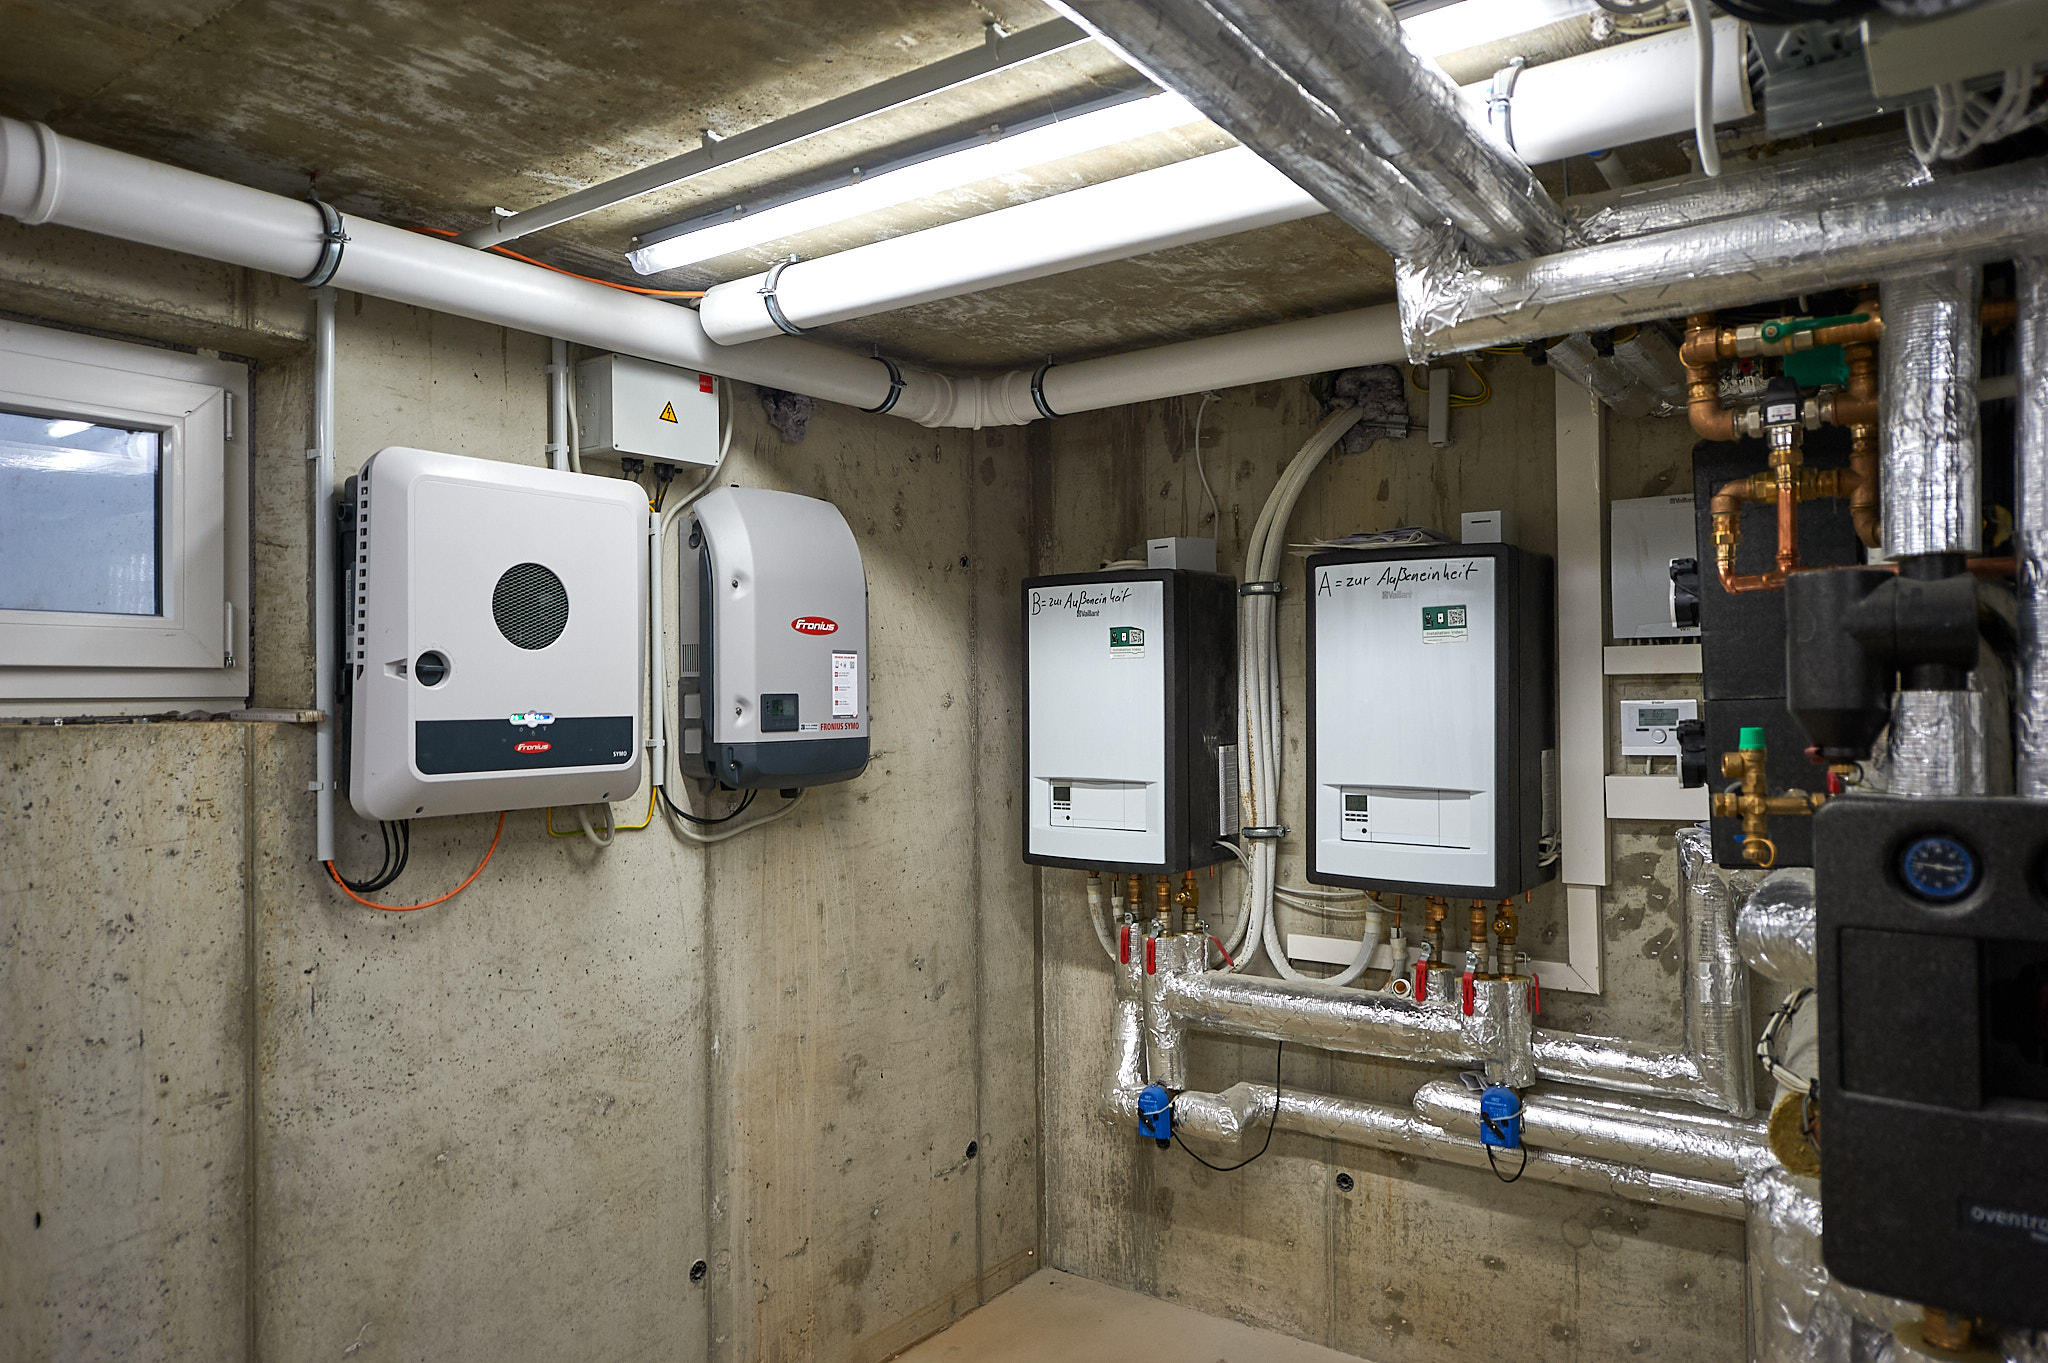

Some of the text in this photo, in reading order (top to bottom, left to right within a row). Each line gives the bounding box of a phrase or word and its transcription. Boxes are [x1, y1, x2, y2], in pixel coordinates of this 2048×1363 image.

[1377, 561, 1479, 591] Außeneinheit
[1388, 590, 1412, 599] Vaillant
[795, 619, 835, 631] Fronius
[820, 723, 844, 731] FRONIUS
[844, 722, 860, 730] SYMO
[517, 743, 549, 751] Fronius
